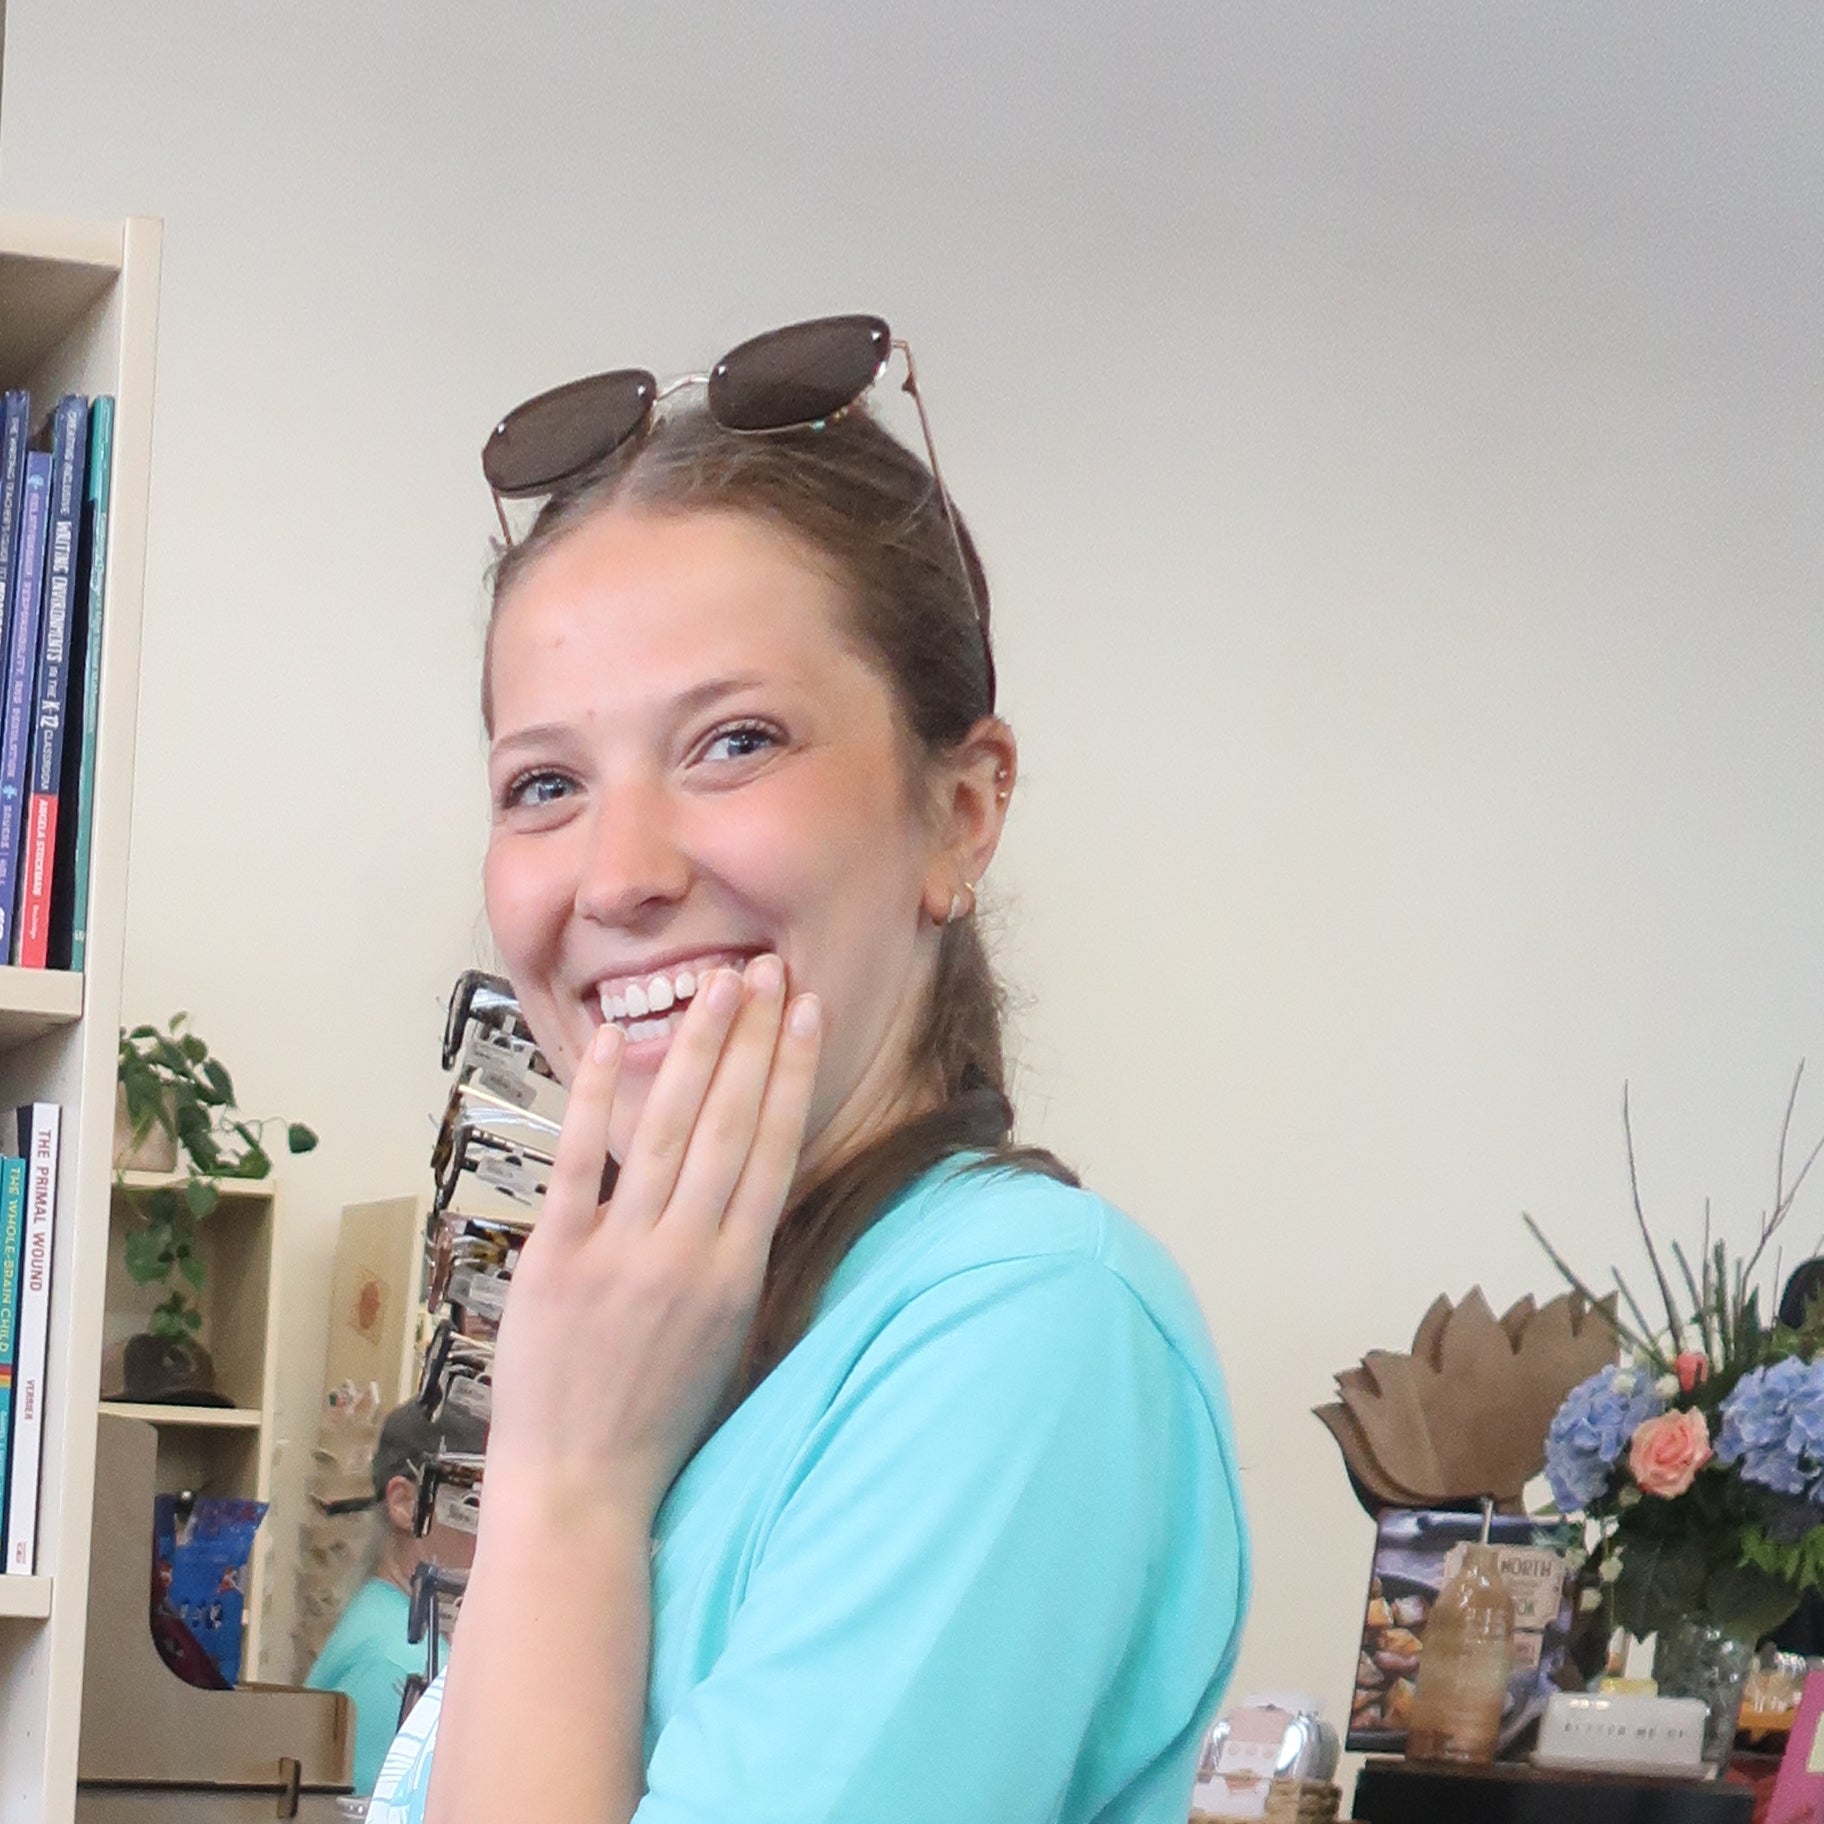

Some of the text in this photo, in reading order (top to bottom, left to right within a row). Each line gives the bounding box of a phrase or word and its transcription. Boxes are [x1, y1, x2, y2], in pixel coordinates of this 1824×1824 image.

[30, 1129, 51, 1292] THE PRIMAL WOUND
